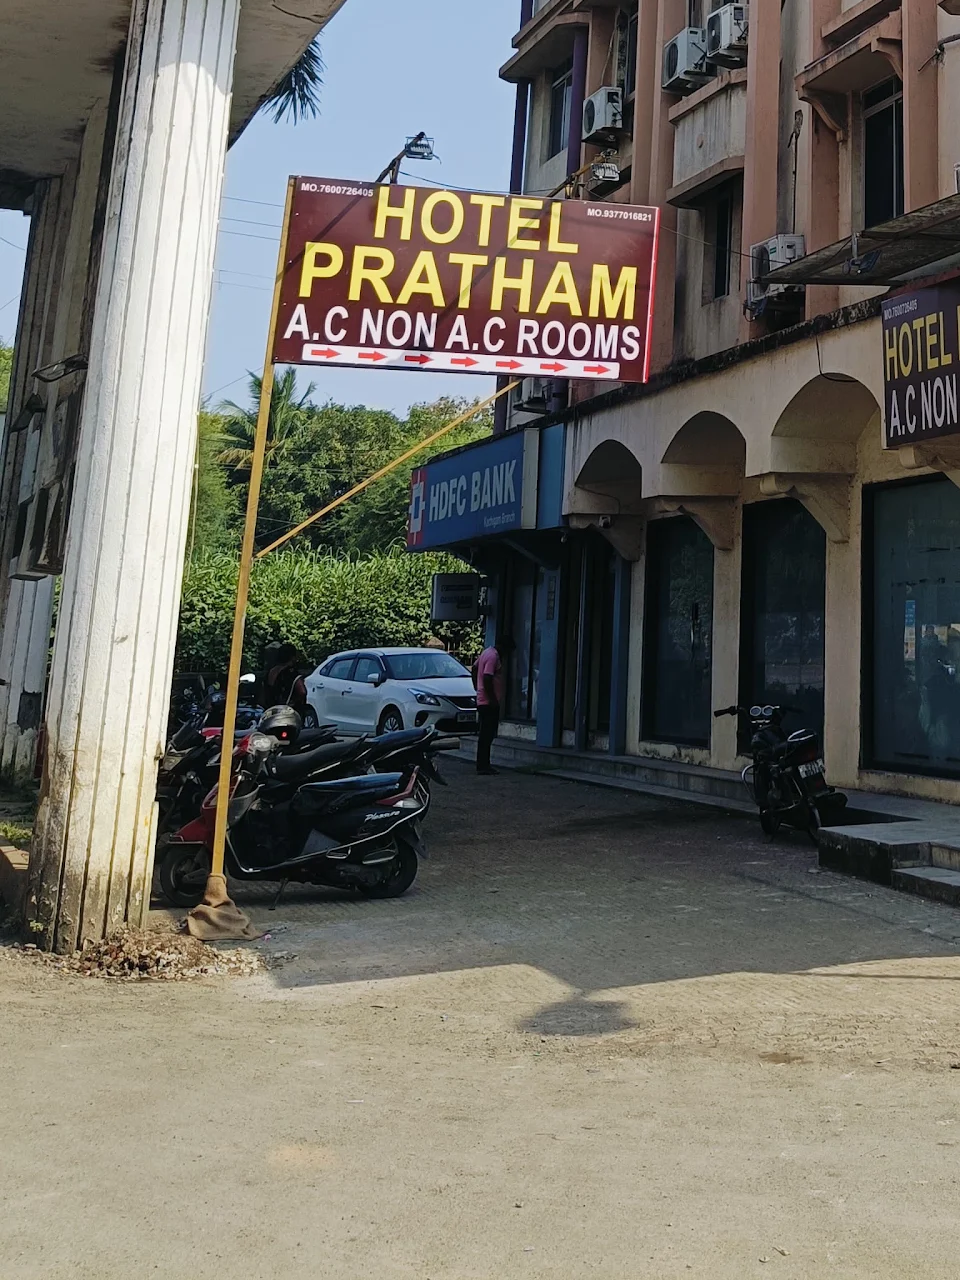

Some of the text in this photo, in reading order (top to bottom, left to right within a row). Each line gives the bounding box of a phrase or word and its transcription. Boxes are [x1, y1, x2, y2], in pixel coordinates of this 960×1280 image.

[301, 182, 374, 197] MO.7600726405
[373, 186, 579, 255] HOTEL
[587, 208, 652, 222] MO.9377016821
[299, 241, 637, 320] PRATHAM
[284, 303, 641, 361] A.C NON A.C ROOMS
[885, 312, 952, 382] HOTEL
[890, 384, 917, 438] A.C
[921, 373, 957, 431] NON
[429, 460, 516, 522] HDFC BANK
